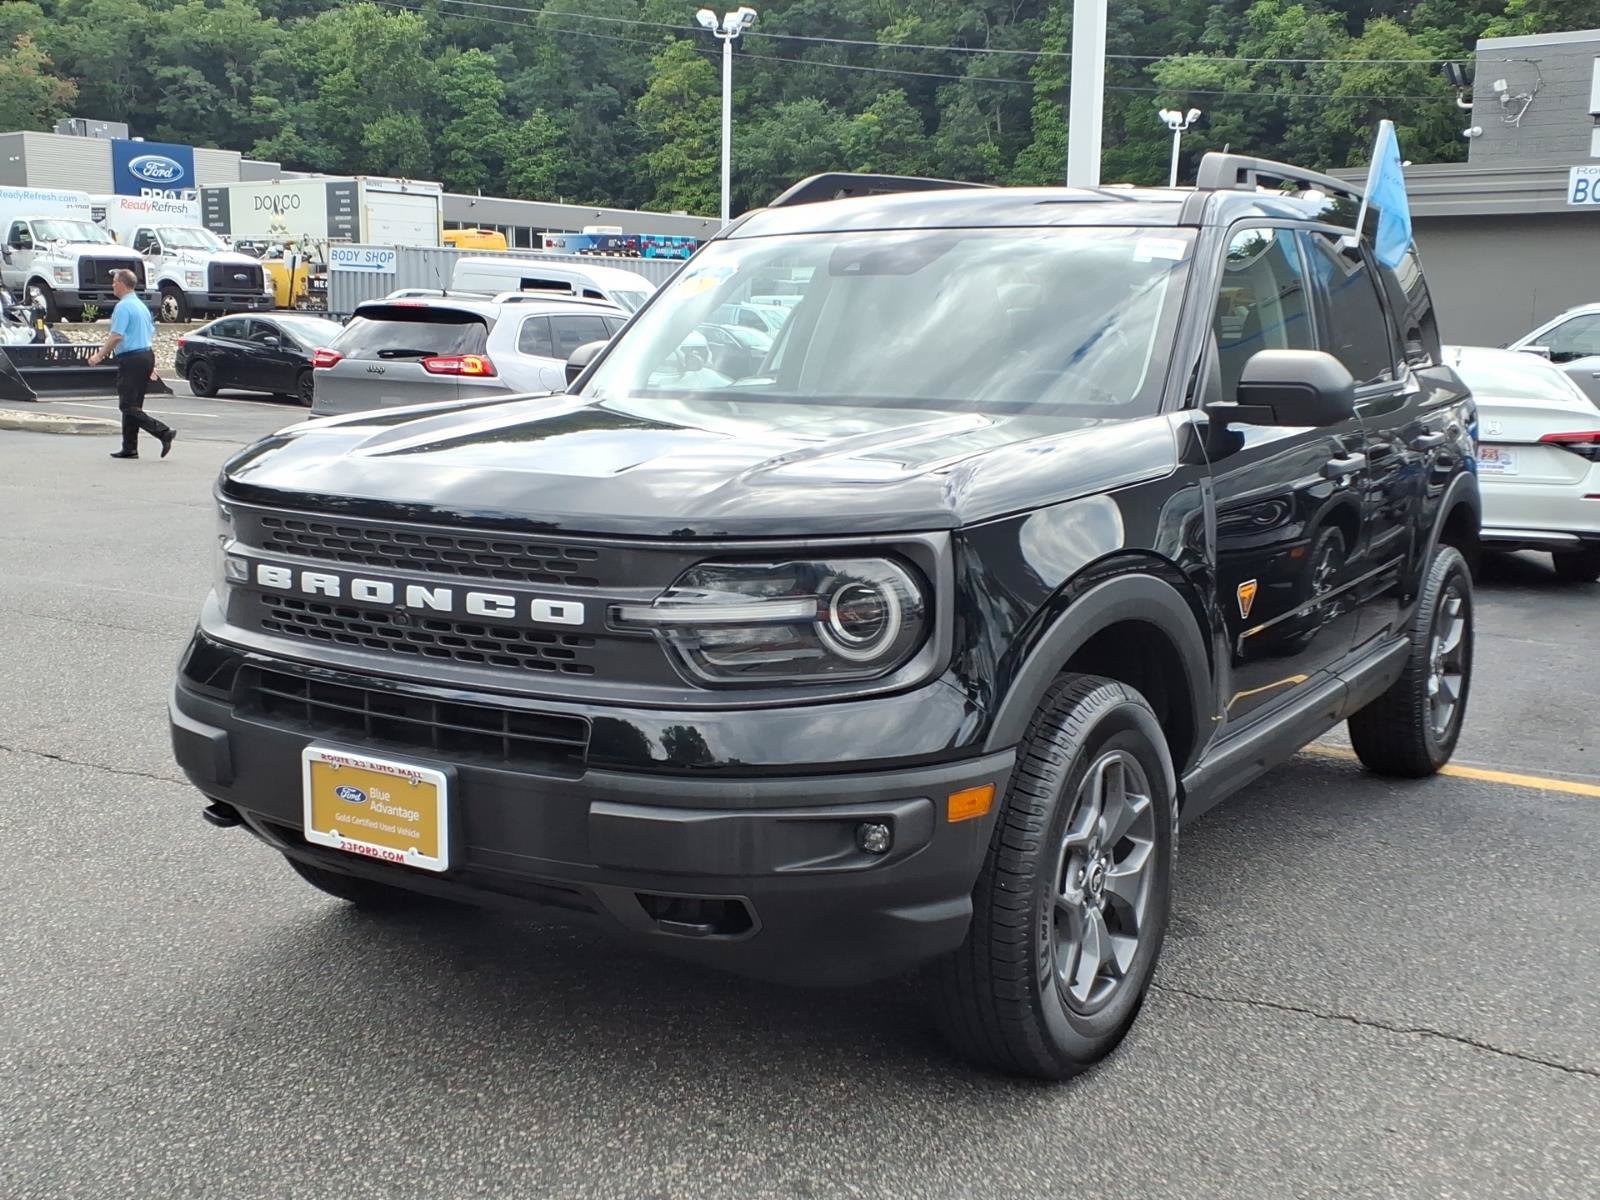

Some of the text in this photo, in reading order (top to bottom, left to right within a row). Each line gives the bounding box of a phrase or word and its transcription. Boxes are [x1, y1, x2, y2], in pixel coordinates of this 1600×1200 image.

[120, 199, 188, 213] ReadyRefresh
[331, 250, 394, 263] BODY SHOP
[257, 564, 585, 626] BRONCO
[320, 753, 423, 779] ROUTE 23 AUTO MALL
[340, 786, 362, 802] Ford
[369, 787, 391, 802] Blue
[370, 801, 420, 822] Advantage
[335, 812, 420, 839] Gold Certified Used Vehicle
[340, 841, 405, 862] 23FORD.COM
